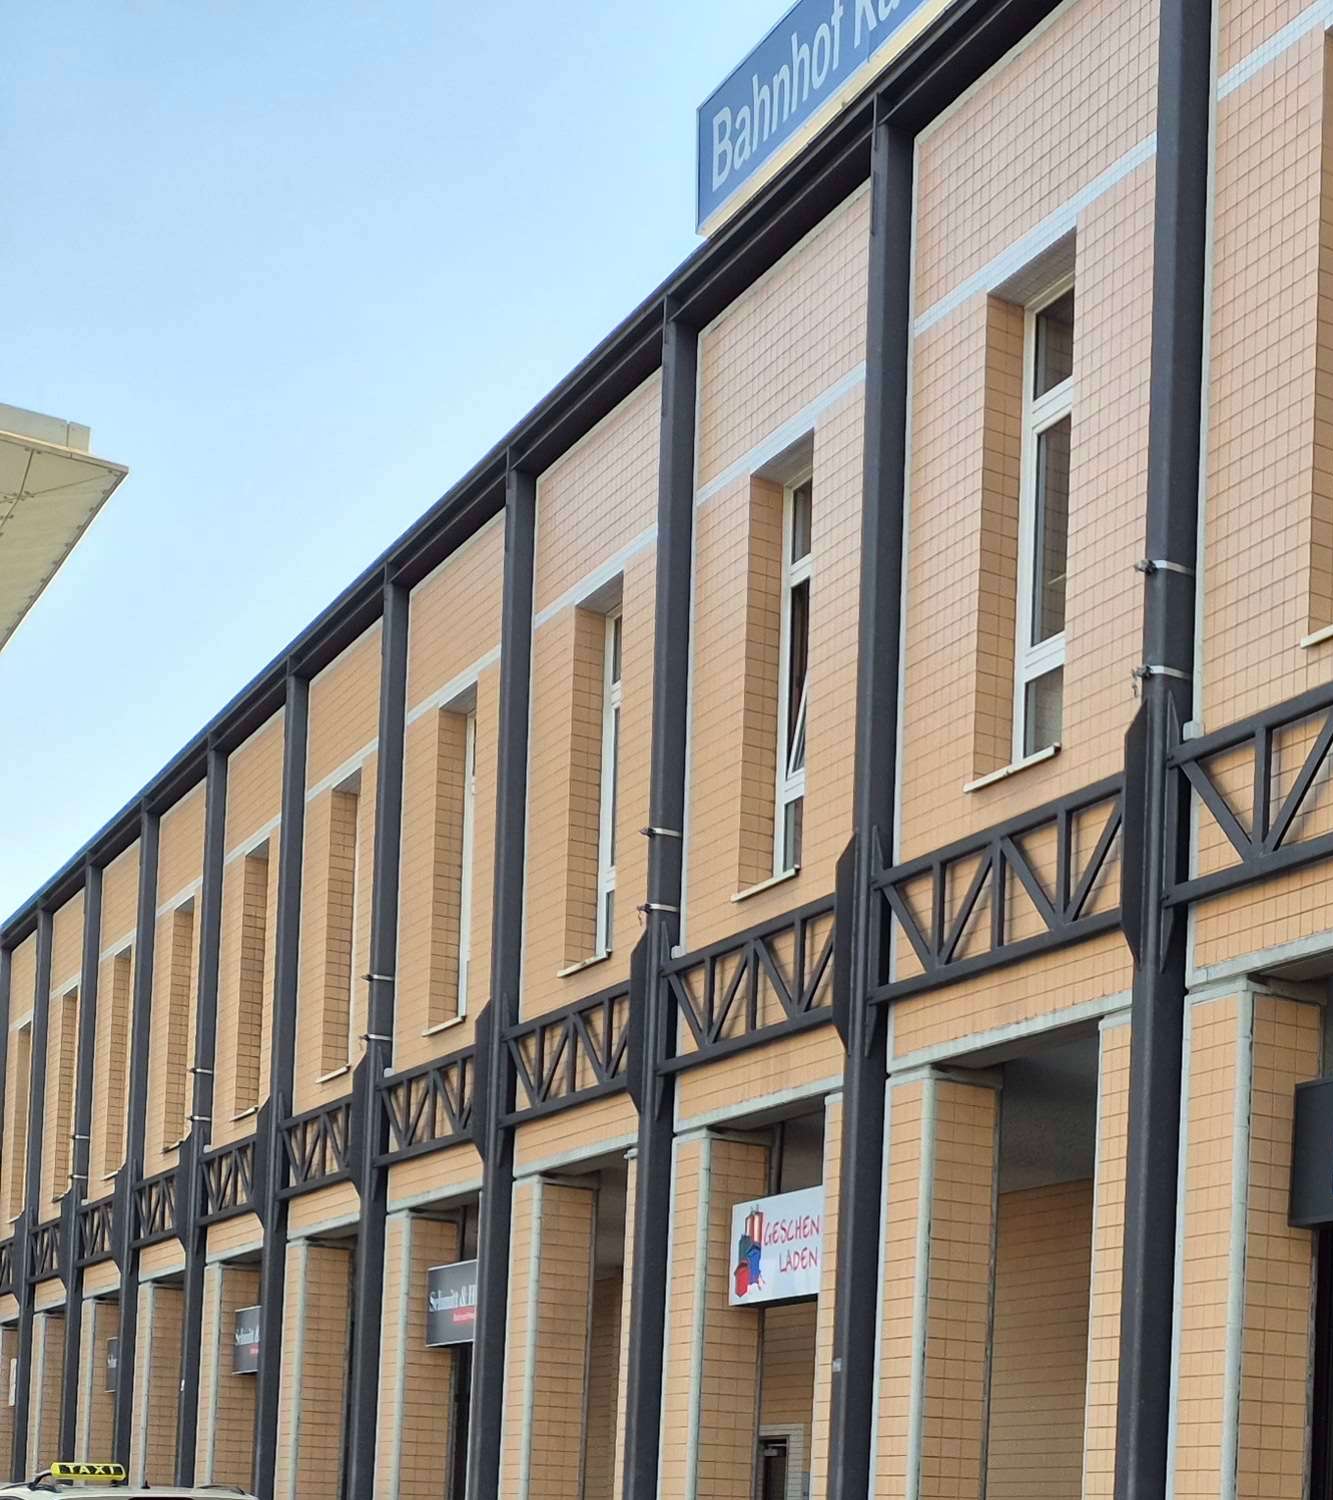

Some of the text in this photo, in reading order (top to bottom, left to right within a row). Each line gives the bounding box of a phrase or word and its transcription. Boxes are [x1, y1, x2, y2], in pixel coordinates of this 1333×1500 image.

[712, 0, 844, 192] Bahnhof
[779, 1246, 818, 1272] LADEN
[67, 1465, 115, 1475] TAXI
